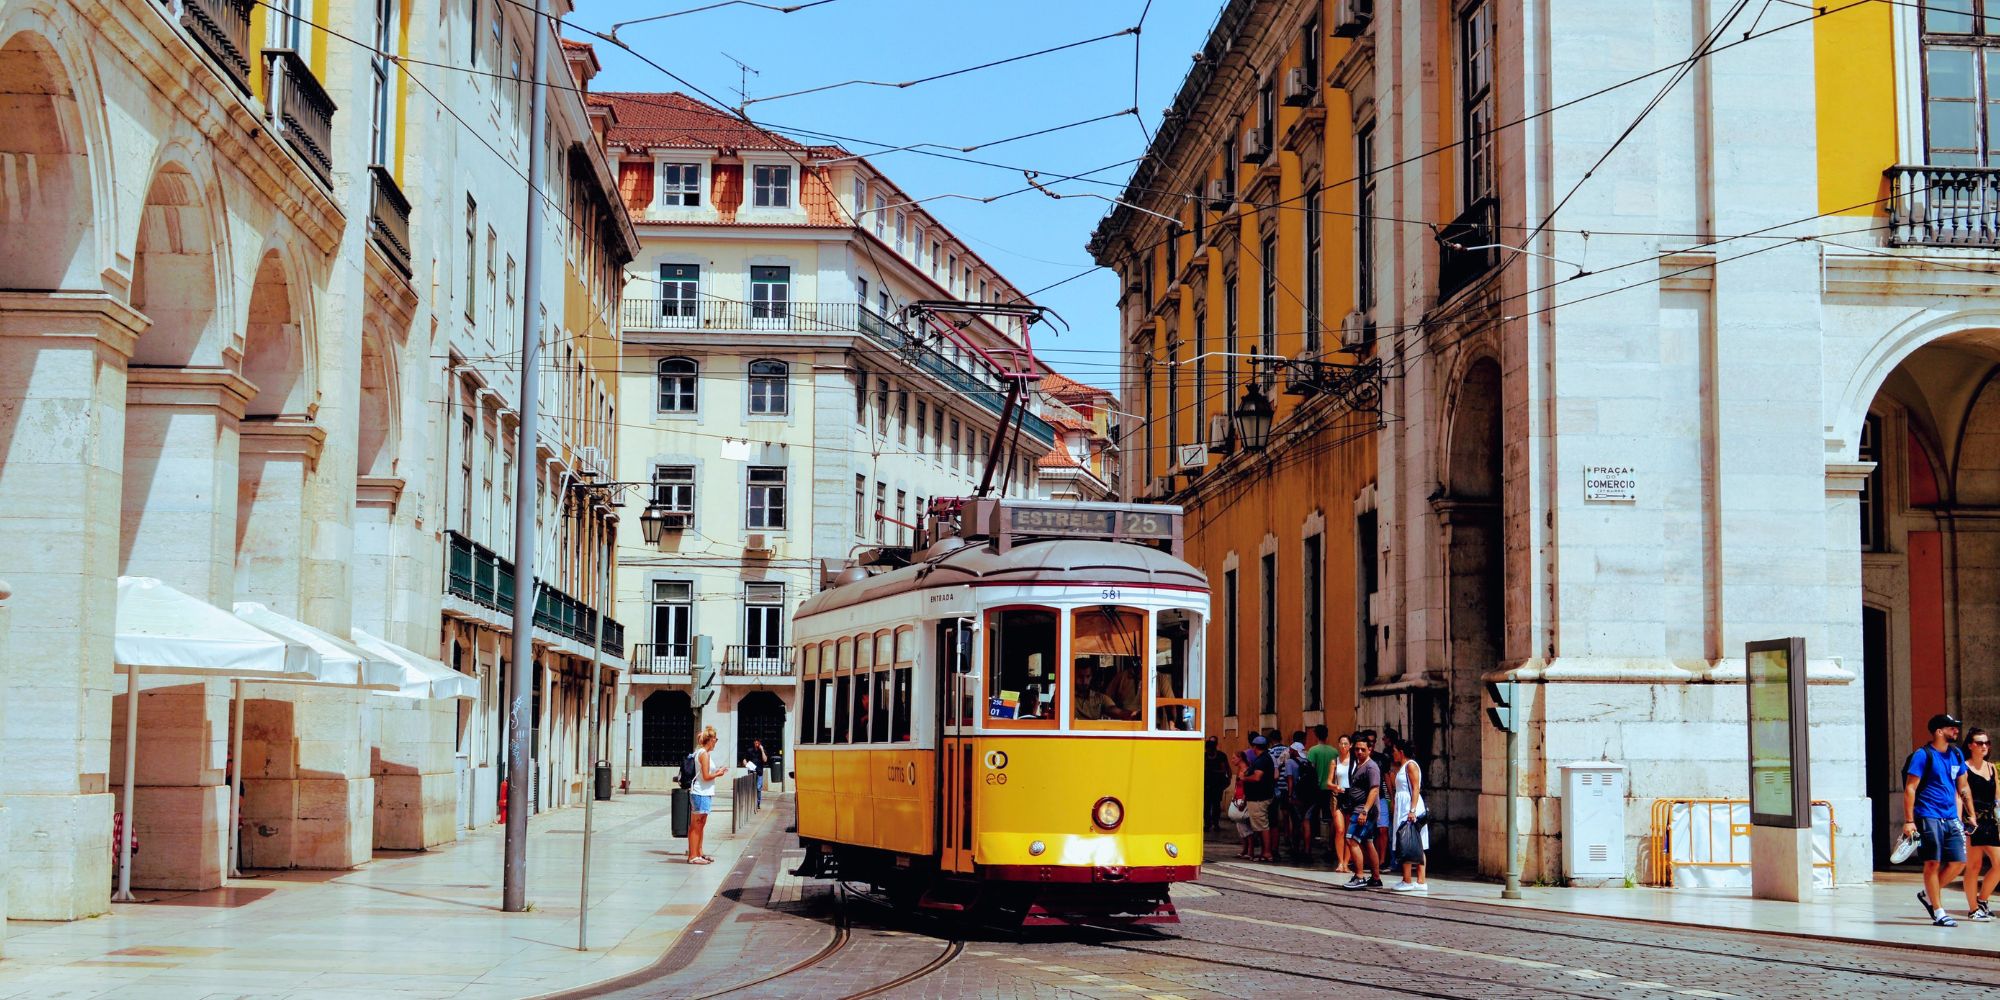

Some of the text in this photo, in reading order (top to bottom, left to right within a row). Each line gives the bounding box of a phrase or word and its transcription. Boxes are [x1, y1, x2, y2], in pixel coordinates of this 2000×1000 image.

[1593, 467, 1628, 476] PRAÇA
[1587, 480, 1635, 489] COMERCIO
[1017, 510, 1157, 533] ESTRELA 25
[930, 593, 954, 603] ENTRADA
[1101, 590, 1121, 600] 581
[990, 708, 1000, 716] 01
